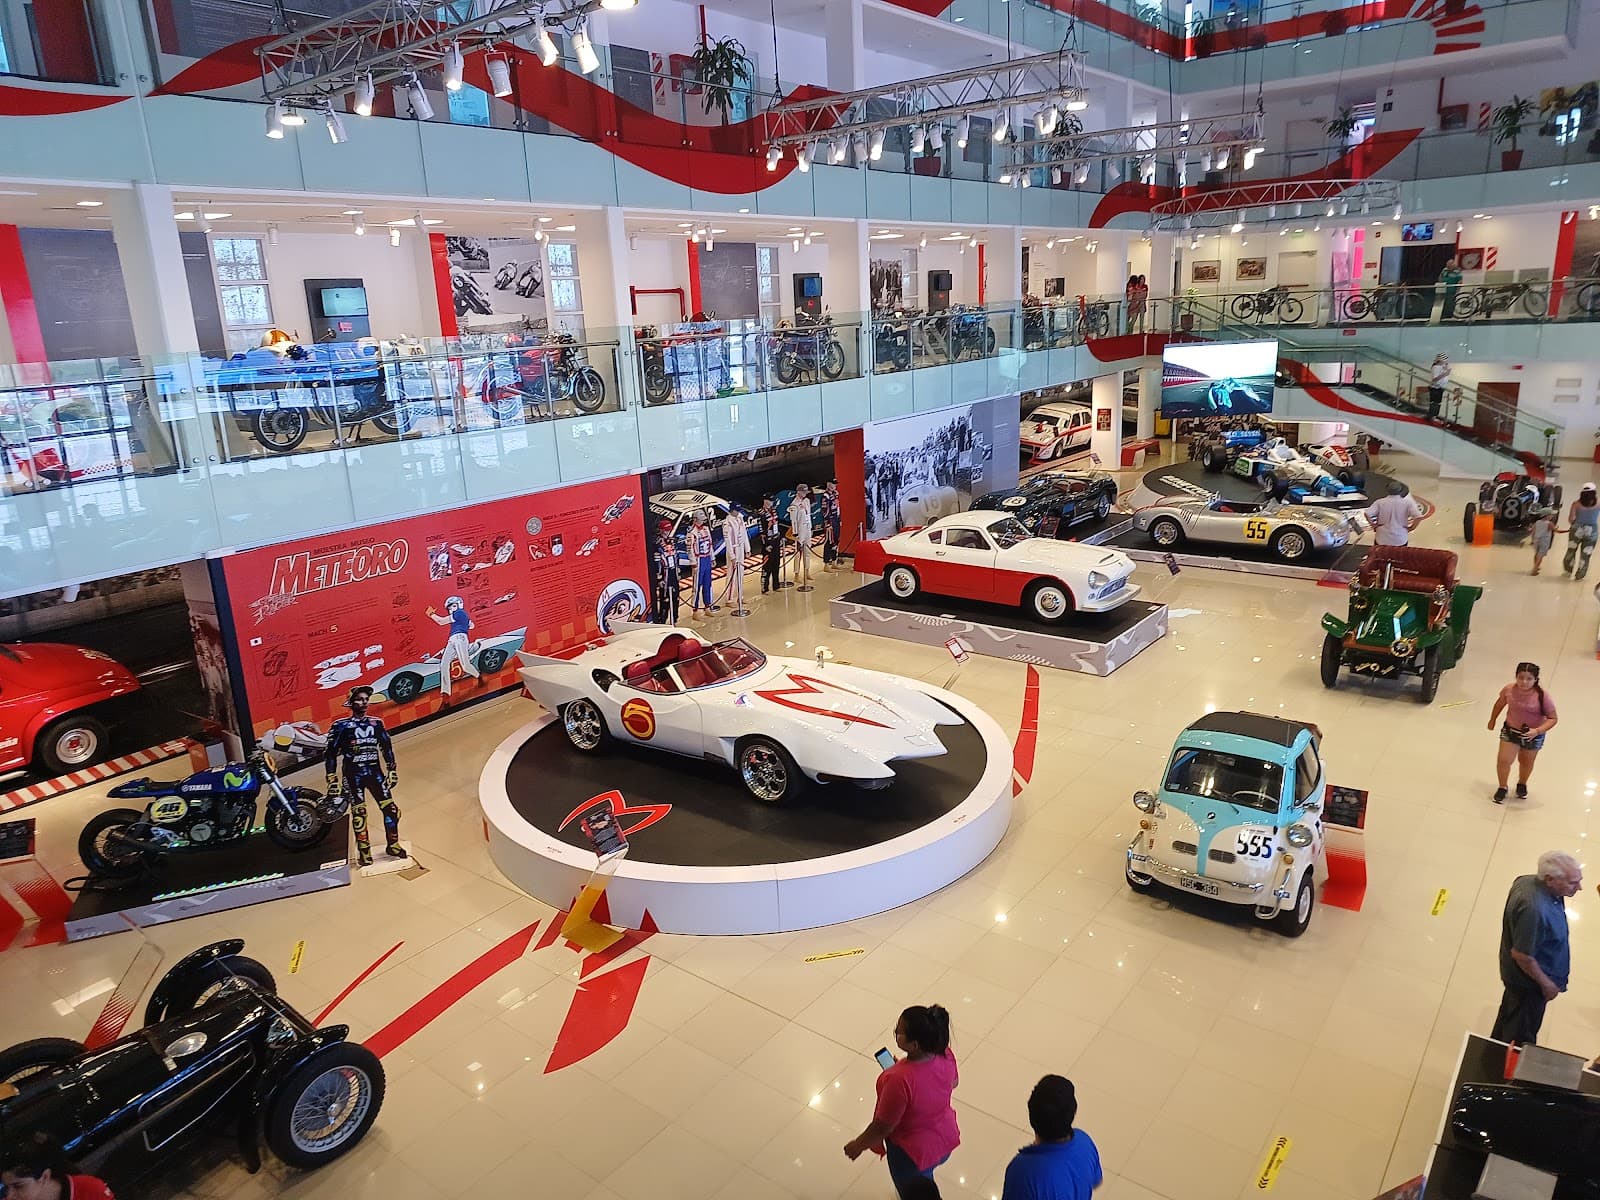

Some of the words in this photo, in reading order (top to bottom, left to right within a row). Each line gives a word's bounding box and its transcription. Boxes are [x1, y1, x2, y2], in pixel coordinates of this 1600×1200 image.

[1504, 499, 1519, 519] 8
[1246, 520, 1268, 540] 55
[329, 623, 339, 634] 5
[450, 660, 462, 679] 5
[623, 702, 653, 738] 5
[188, 783, 213, 792] YAMAHA
[1236, 832, 1273, 860] 555
